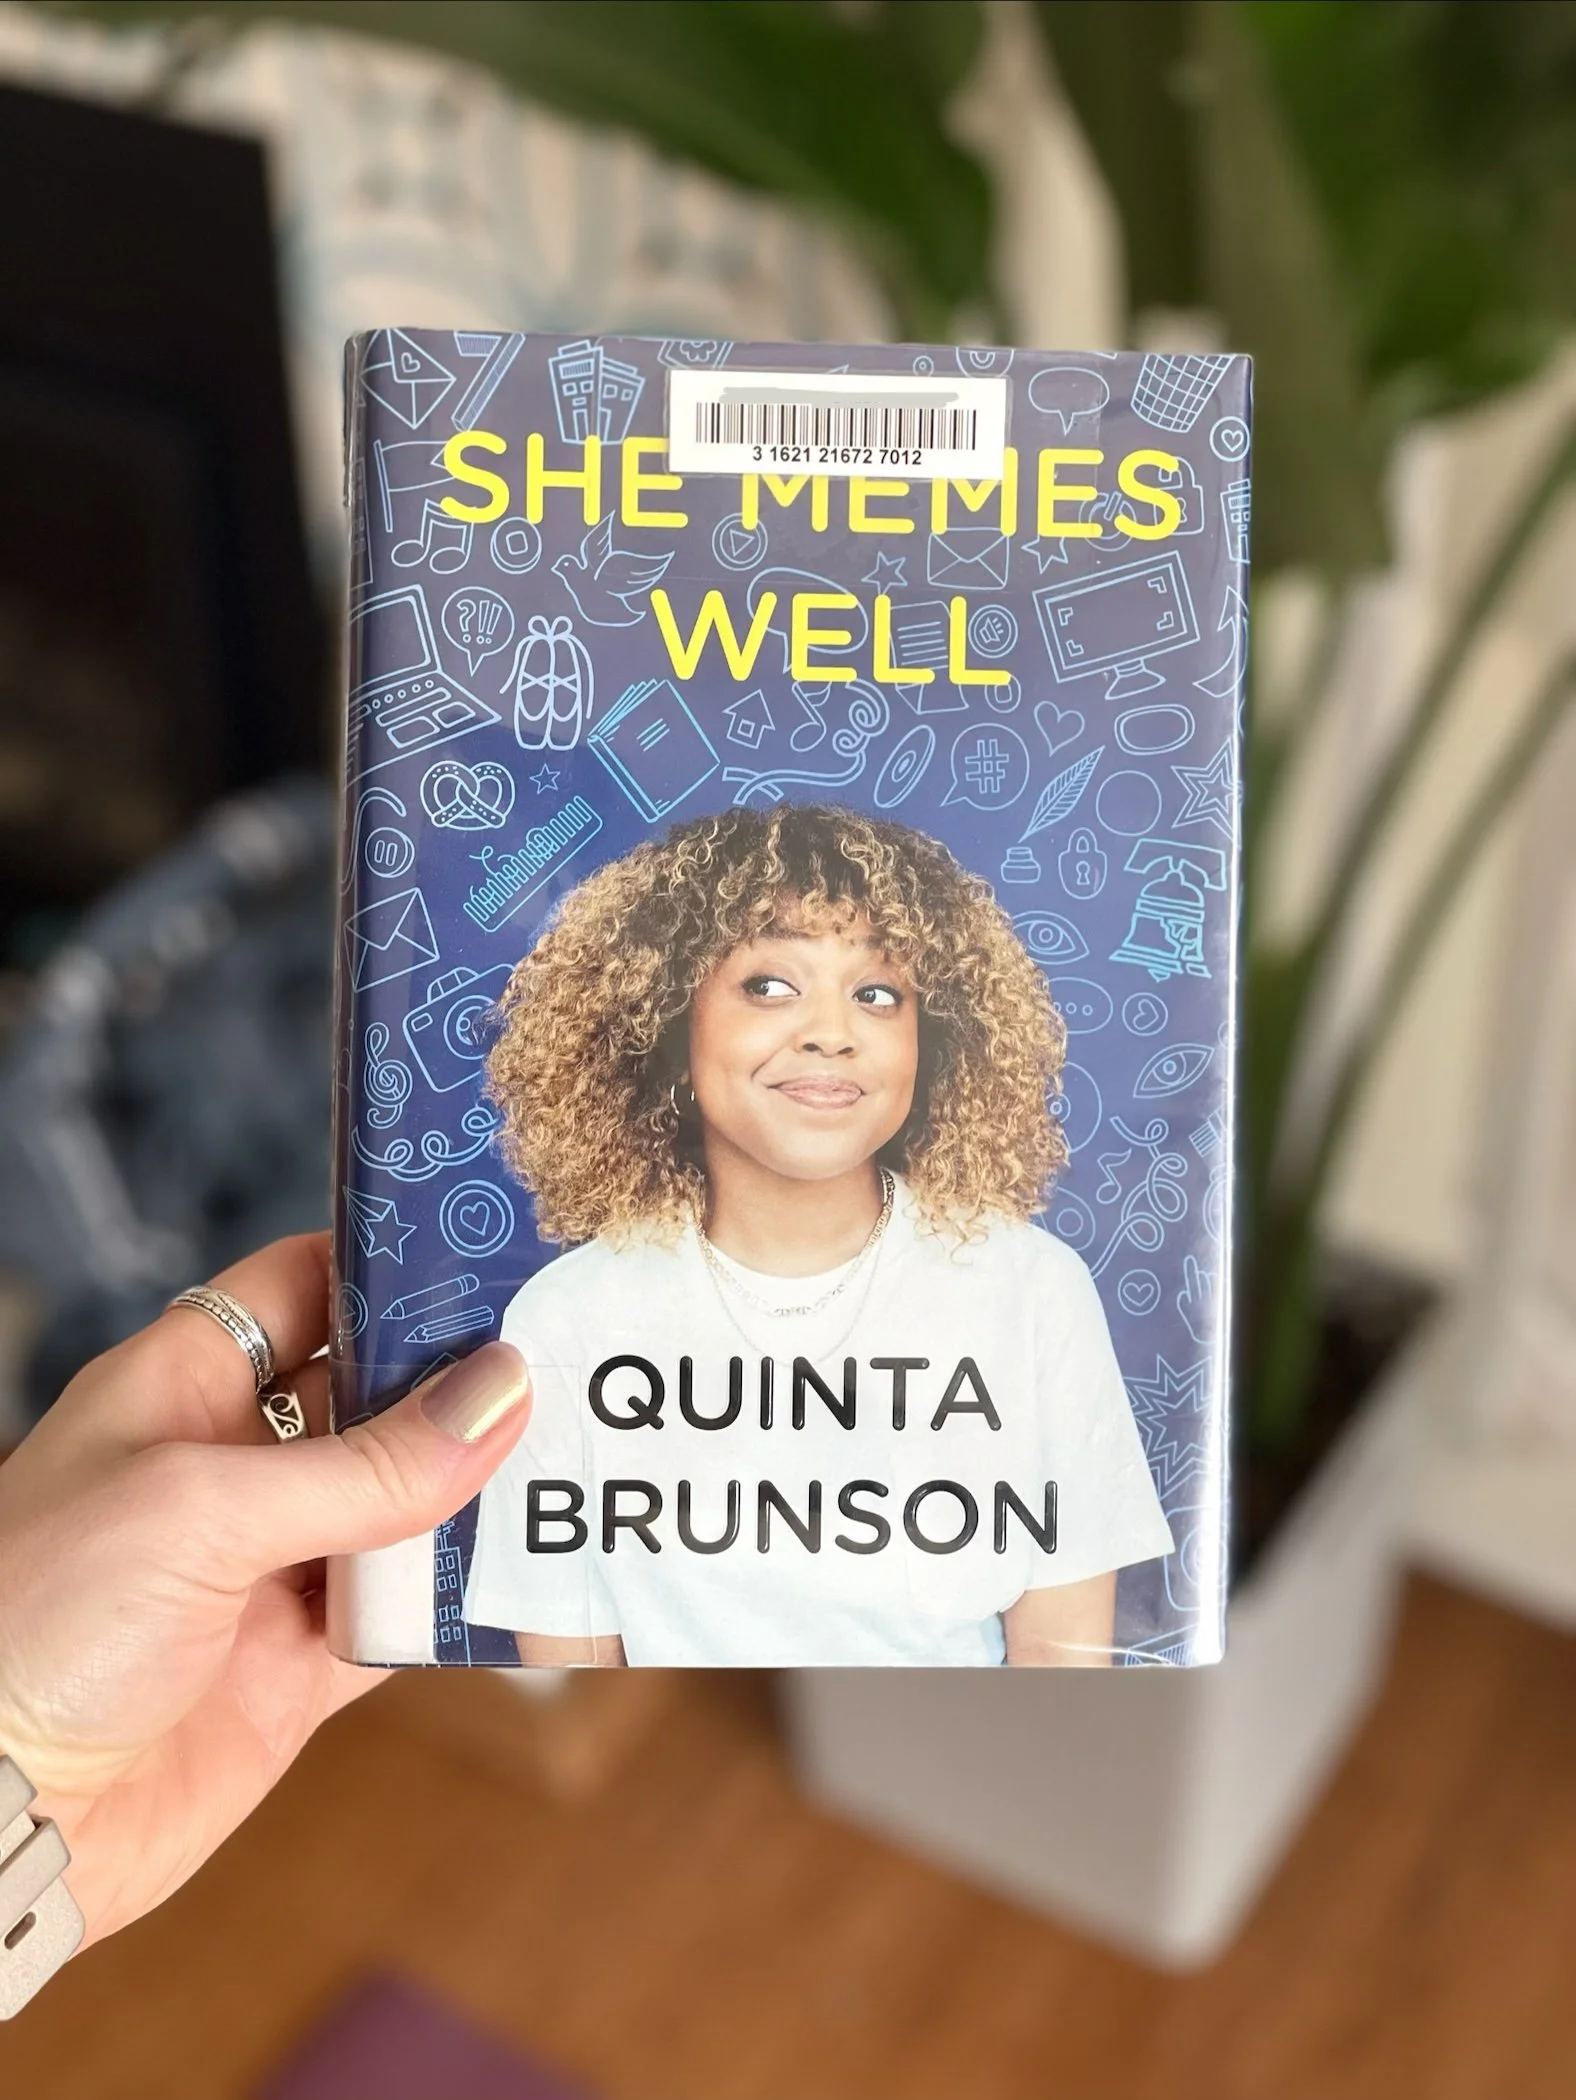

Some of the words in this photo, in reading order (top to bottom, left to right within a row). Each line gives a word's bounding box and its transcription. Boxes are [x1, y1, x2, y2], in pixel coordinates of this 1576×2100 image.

[439, 430, 687, 528] SHE
[740, 447, 1182, 541] MEMES
[752, 446, 762, 461] 3
[770, 446, 811, 462] 1621
[819, 447, 873, 464] 21672
[879, 449, 922, 465] 7012
[650, 588, 1010, 685] WELL
[588, 1354, 1002, 1432] QUINTA
[526, 1479, 1058, 1556] BRUNSON
